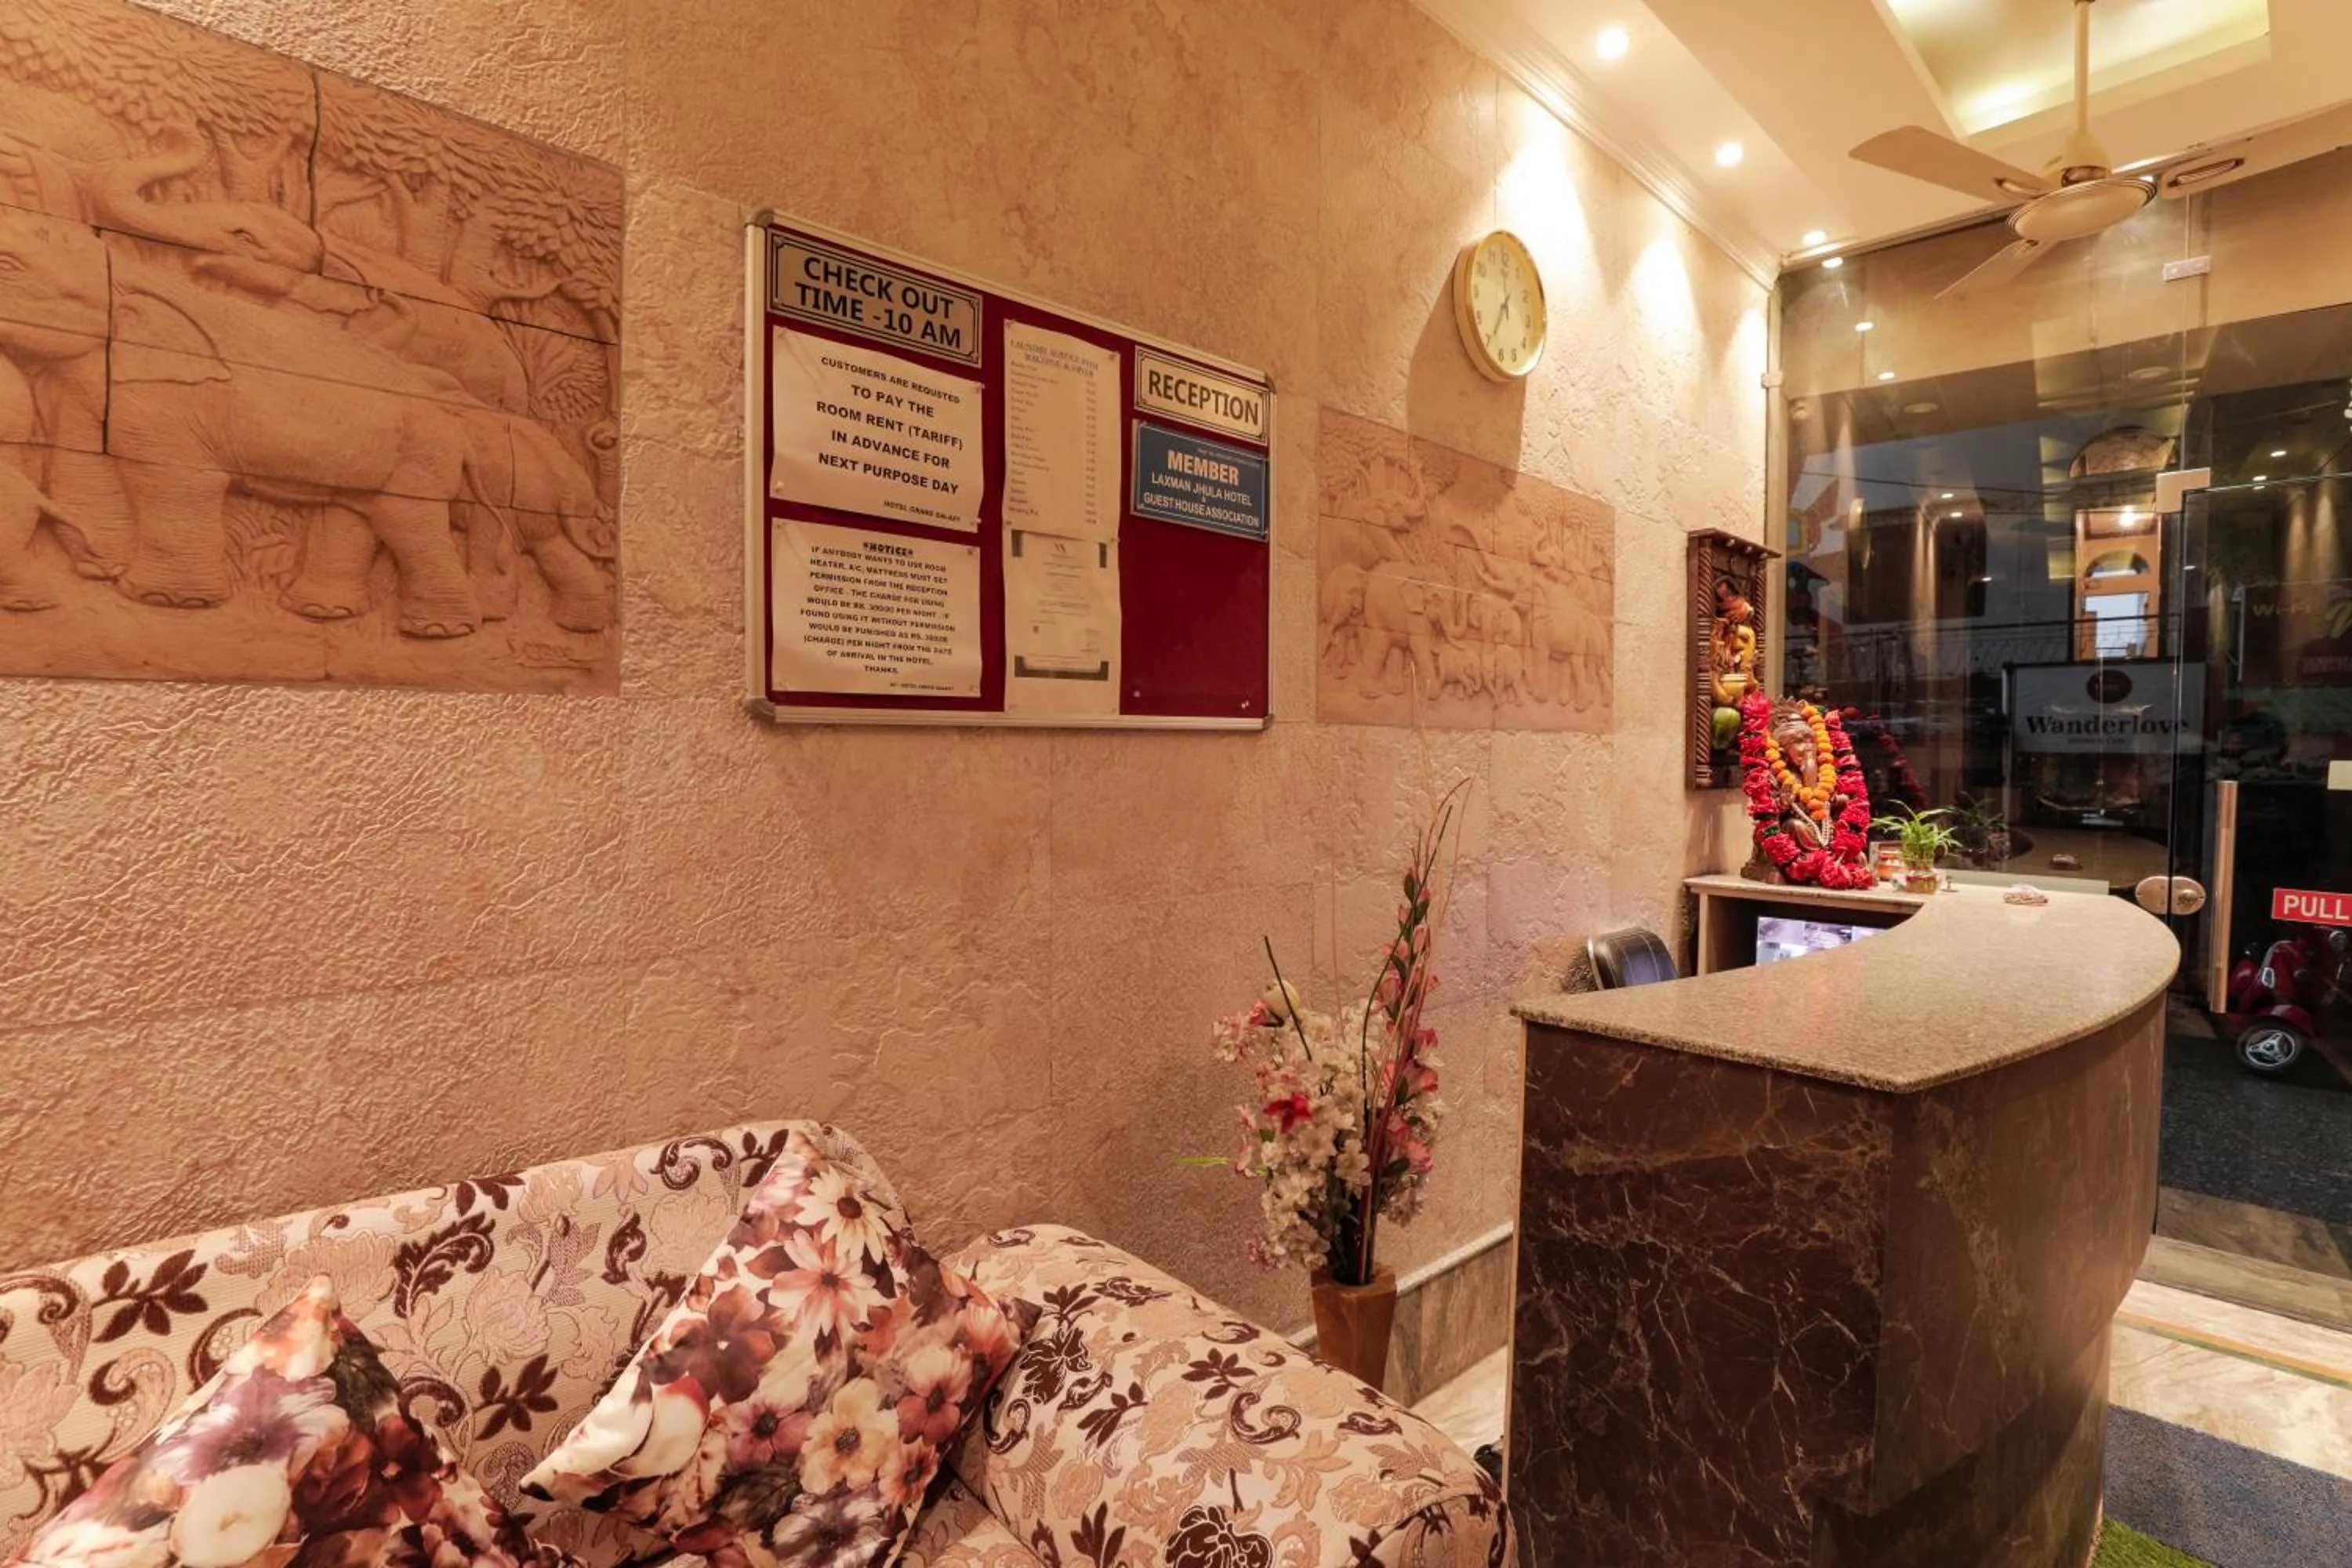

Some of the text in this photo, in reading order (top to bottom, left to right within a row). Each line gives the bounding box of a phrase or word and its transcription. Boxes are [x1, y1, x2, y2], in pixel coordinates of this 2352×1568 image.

[804, 256, 953, 319] CHECK OUT
[795, 281, 862, 321] TIME
[920, 320, 960, 349] AM
[821, 357, 960, 404] CUSTOMERS ARE REQUSTED
[1149, 370, 1258, 425] RECEPTION
[851, 384, 935, 418] TO PAY THE
[816, 401, 964, 450] ROOM RENT (TARIFF)
[832, 430, 950, 469] IN ADVANCE FOR
[1167, 449, 1240, 486] MEMBER
[818, 452, 959, 495] NEXT PURPOSE DAY
[1152, 472, 1253, 506] LAXMAN JHULA HOTEL
[1144, 492, 1259, 527] GUEST HOUSE ASSOCIATION
[2027, 715, 2190, 735] Wanderlove
[2284, 895, 2350, 920] PULL
